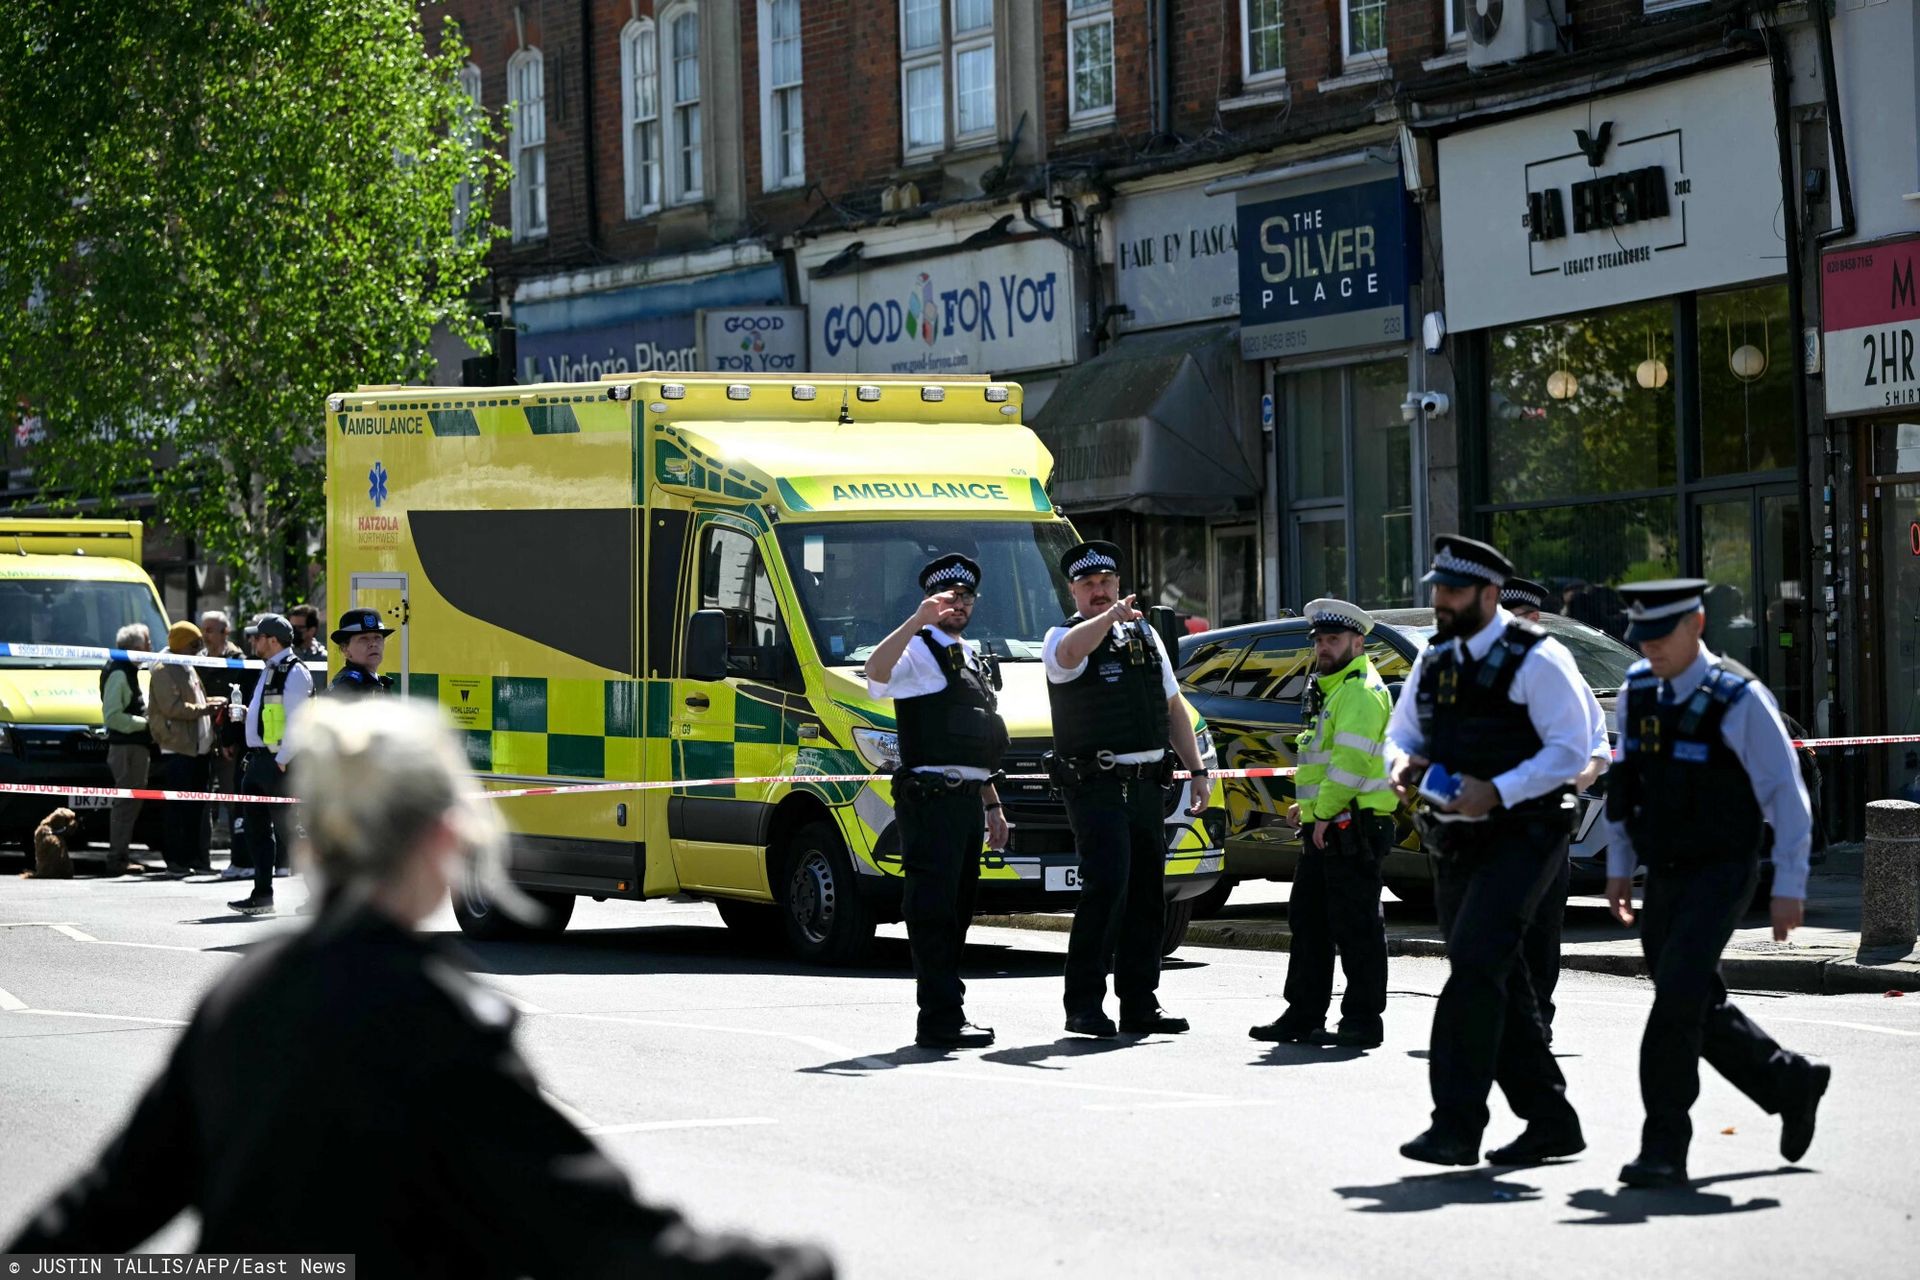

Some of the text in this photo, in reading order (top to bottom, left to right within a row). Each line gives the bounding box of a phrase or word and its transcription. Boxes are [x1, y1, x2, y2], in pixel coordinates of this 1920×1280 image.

[1293, 209, 1322, 231] THE
[1120, 237, 1157, 270] HAIR
[1163, 231, 1183, 263] BY
[1260, 216, 1376, 283] SILVER
[1563, 245, 1651, 276] LEGACY STEAKHOUSE
[1262, 273, 1378, 309] PLACE
[1891, 256, 1916, 310] M
[724, 316, 784, 333] GOOD
[824, 272, 1056, 357] GOOD FOR YOU
[1383, 317, 1401, 335] 233
[717, 353, 795, 372] FOR YOU
[1863, 329, 1916, 387] 2HR
[348, 416, 423, 436] AMBULANCE
[832, 482, 1009, 501] AMBULANCE
[358, 516, 399, 531] HATZOLA
[358, 532, 399, 545] NORTHWEST
[682, 723, 691, 735] G9
